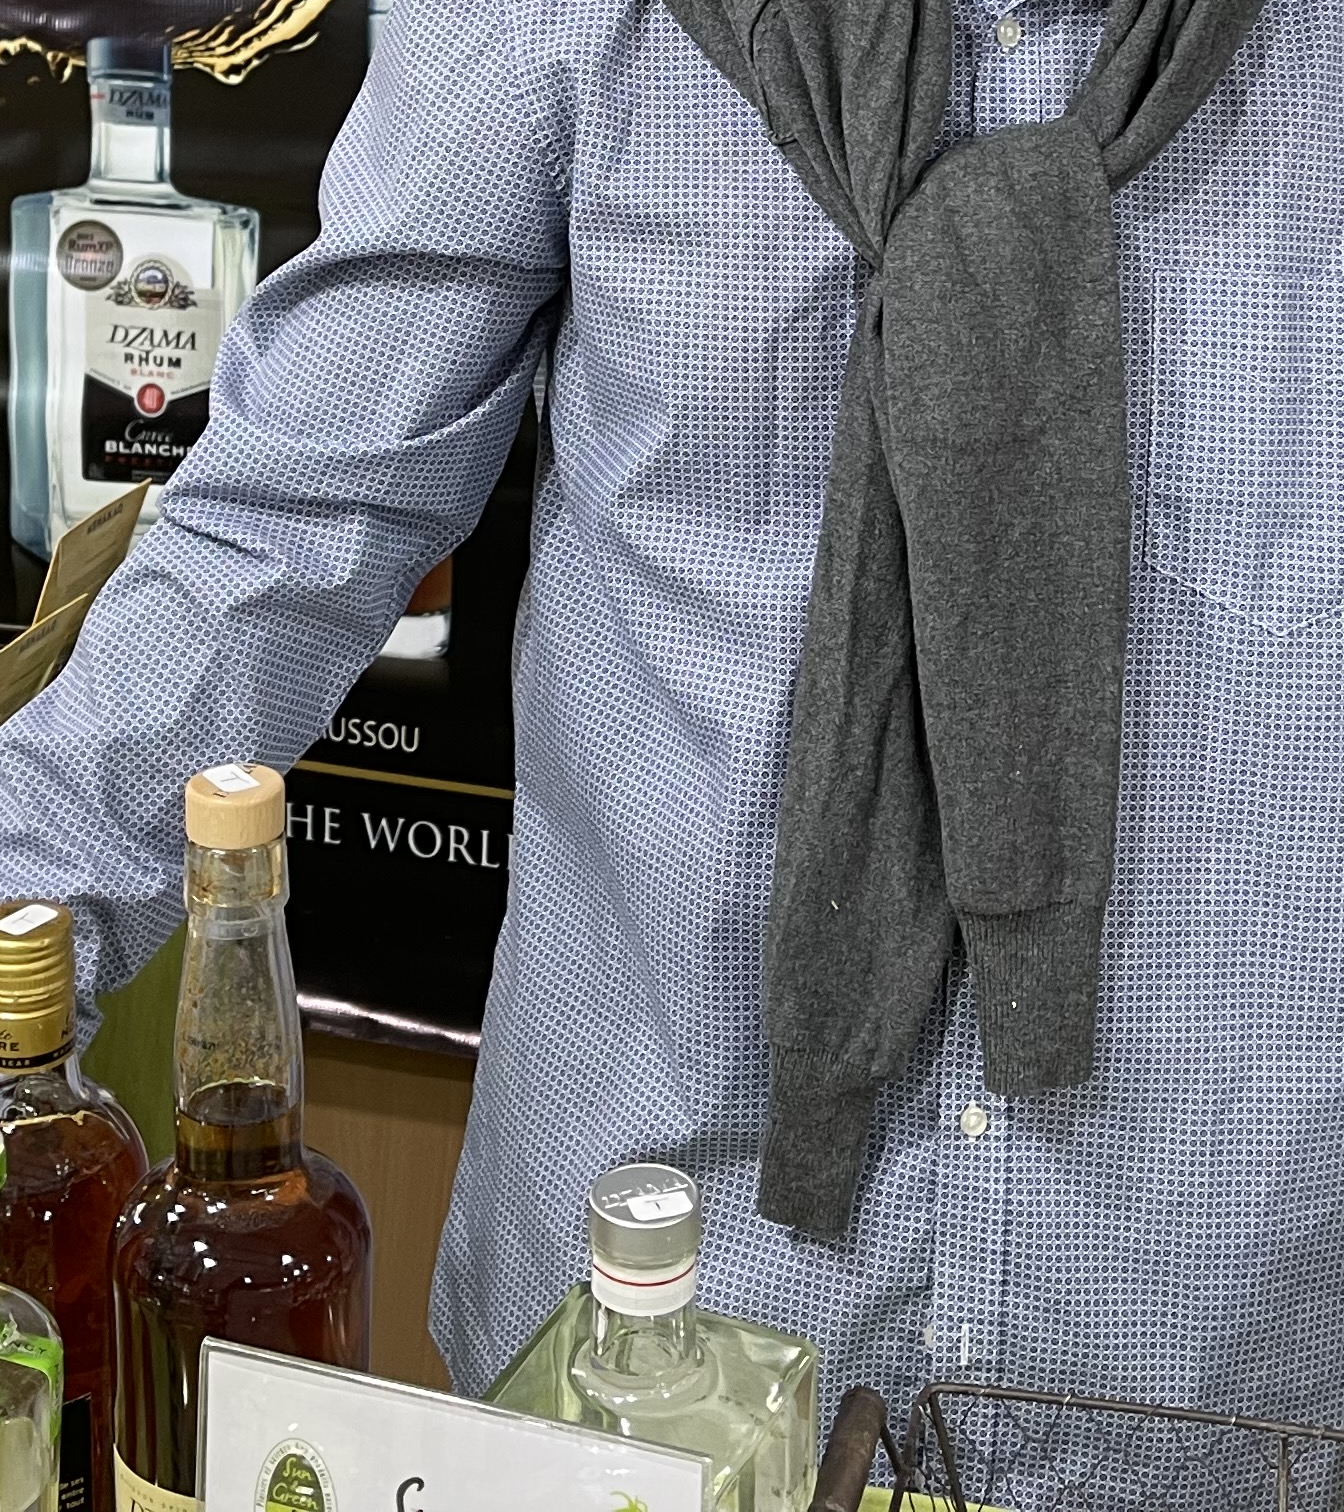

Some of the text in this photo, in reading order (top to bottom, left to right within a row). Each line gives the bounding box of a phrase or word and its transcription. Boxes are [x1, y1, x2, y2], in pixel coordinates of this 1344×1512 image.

[106, 324, 199, 354] DZAMA
[123, 351, 183, 369] RHUM
[322, 716, 421, 753] USSOU
[286, 801, 342, 845] HE
[282, 1456, 313, 1482] Sun
[272, 1482, 320, 1511] Green
